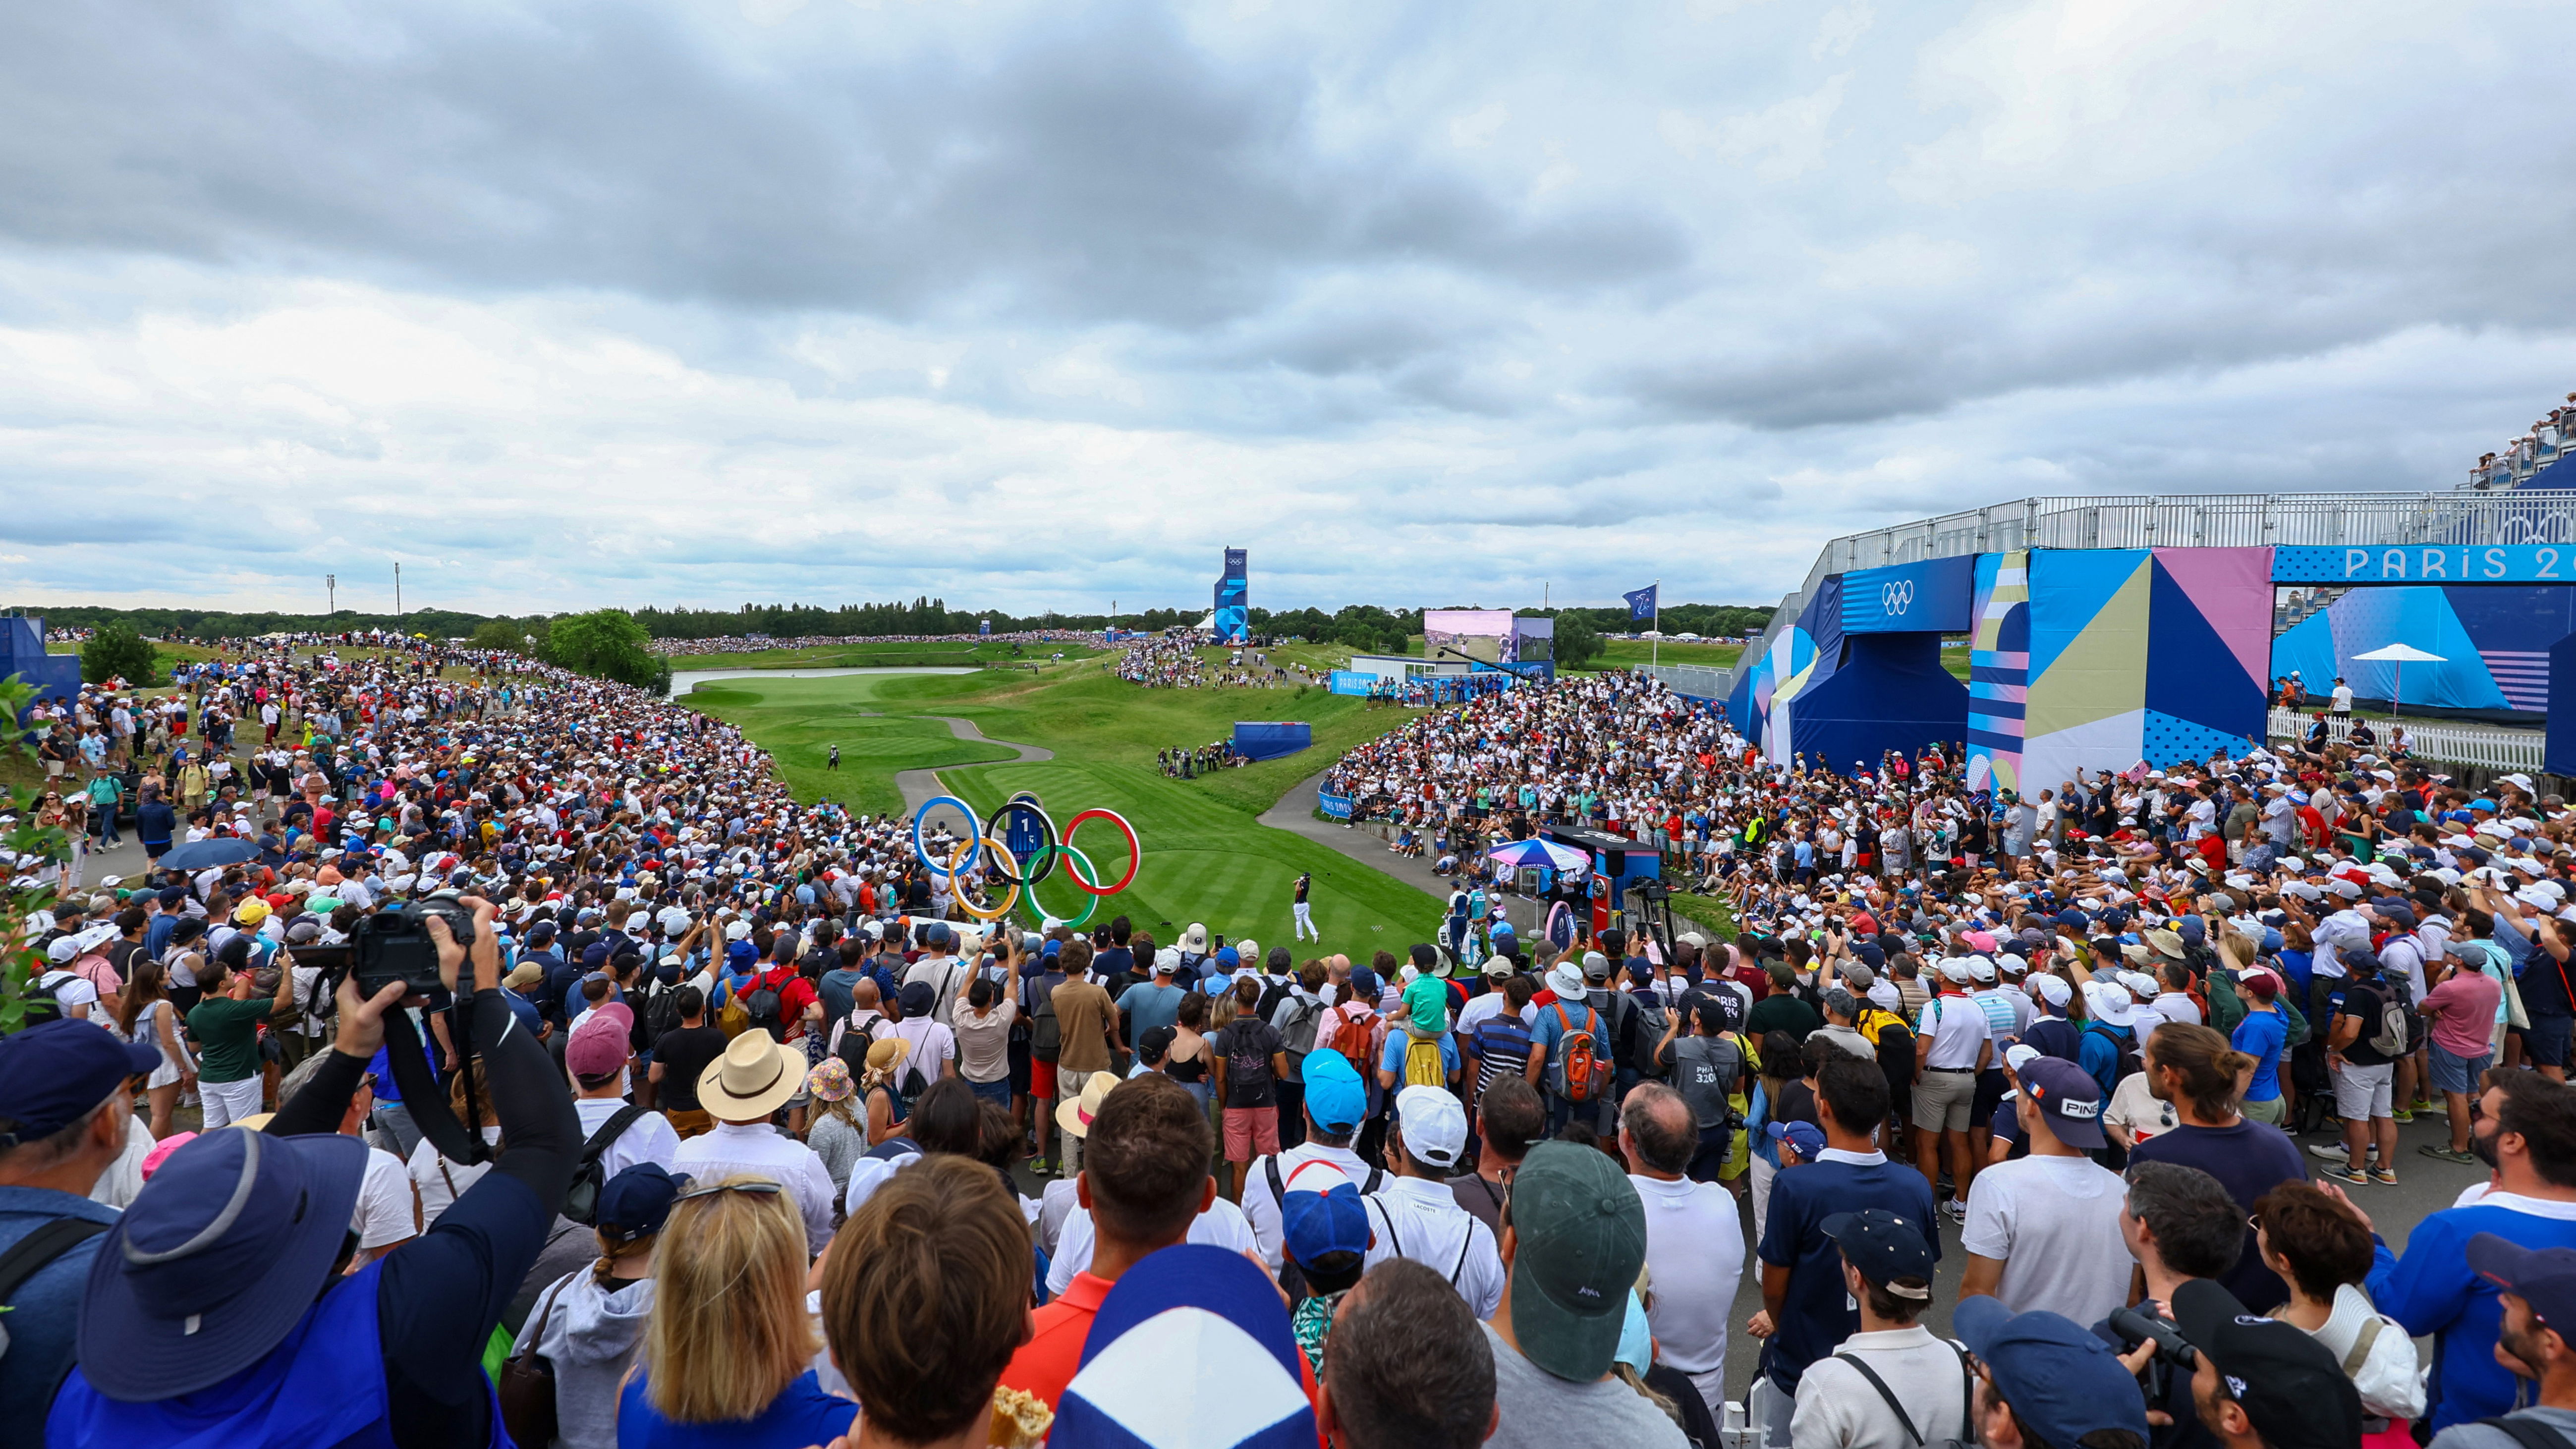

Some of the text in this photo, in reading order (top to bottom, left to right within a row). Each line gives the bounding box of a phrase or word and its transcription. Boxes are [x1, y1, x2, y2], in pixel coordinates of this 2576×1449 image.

[2535, 548, 2576, 578] 2
[1021, 818, 1028, 832] 1
[1440, 932, 1448, 944] FRA
[2066, 1103, 2098, 1115] PING
[1413, 1203, 1436, 1214] LACOSTE
